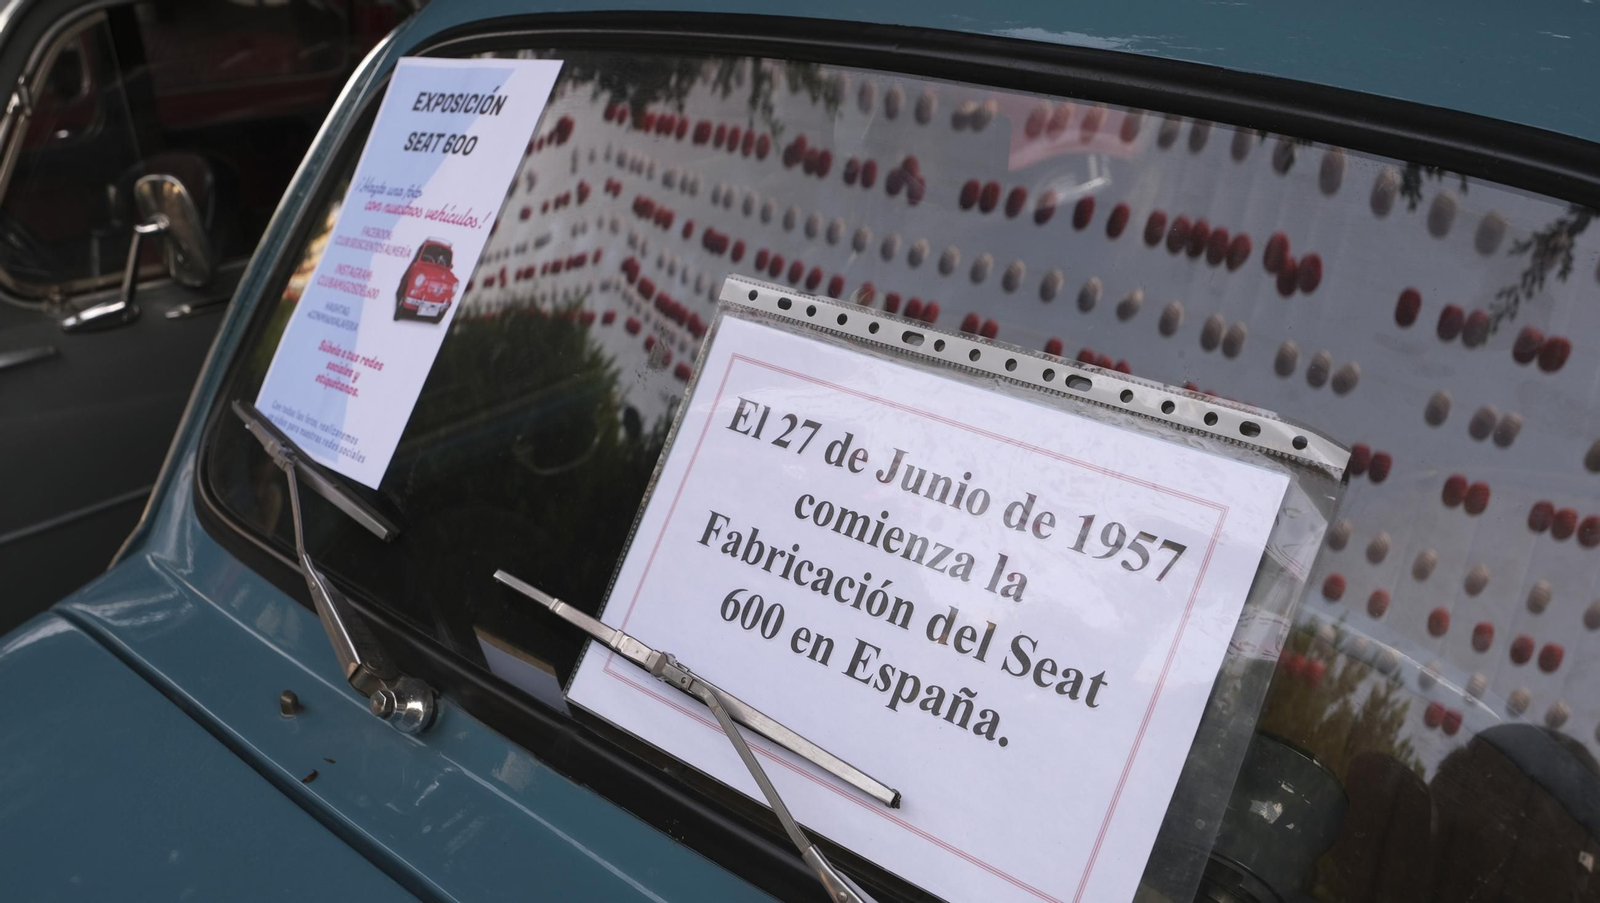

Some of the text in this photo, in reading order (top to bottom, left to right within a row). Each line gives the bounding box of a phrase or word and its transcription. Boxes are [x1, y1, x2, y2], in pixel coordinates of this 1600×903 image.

[412, 85, 508, 116] EXPOSICIÓN
[403, 131, 479, 156] SEAT 600
[387, 187, 403, 197] una
[402, 183, 424, 200] foto
[364, 200, 381, 212] con
[383, 201, 424, 218] nuestros
[326, 361, 361, 383] sociales y
[346, 351, 360, 363] tus
[360, 355, 384, 371] redes
[287, 421, 300, 435] para
[299, 427, 323, 444] nuestras
[321, 437, 340, 452] redes
[338, 445, 366, 464] sociales
[296, 408, 306, 420] las
[319, 422, 359, 446] realizaremos
[725, 396, 1188, 583] El 27 de Junio de 1957
[794, 493, 1030, 603] comienza la
[696, 510, 1109, 709] Fabricación del Seat
[720, 588, 1010, 748] 600 en España.
